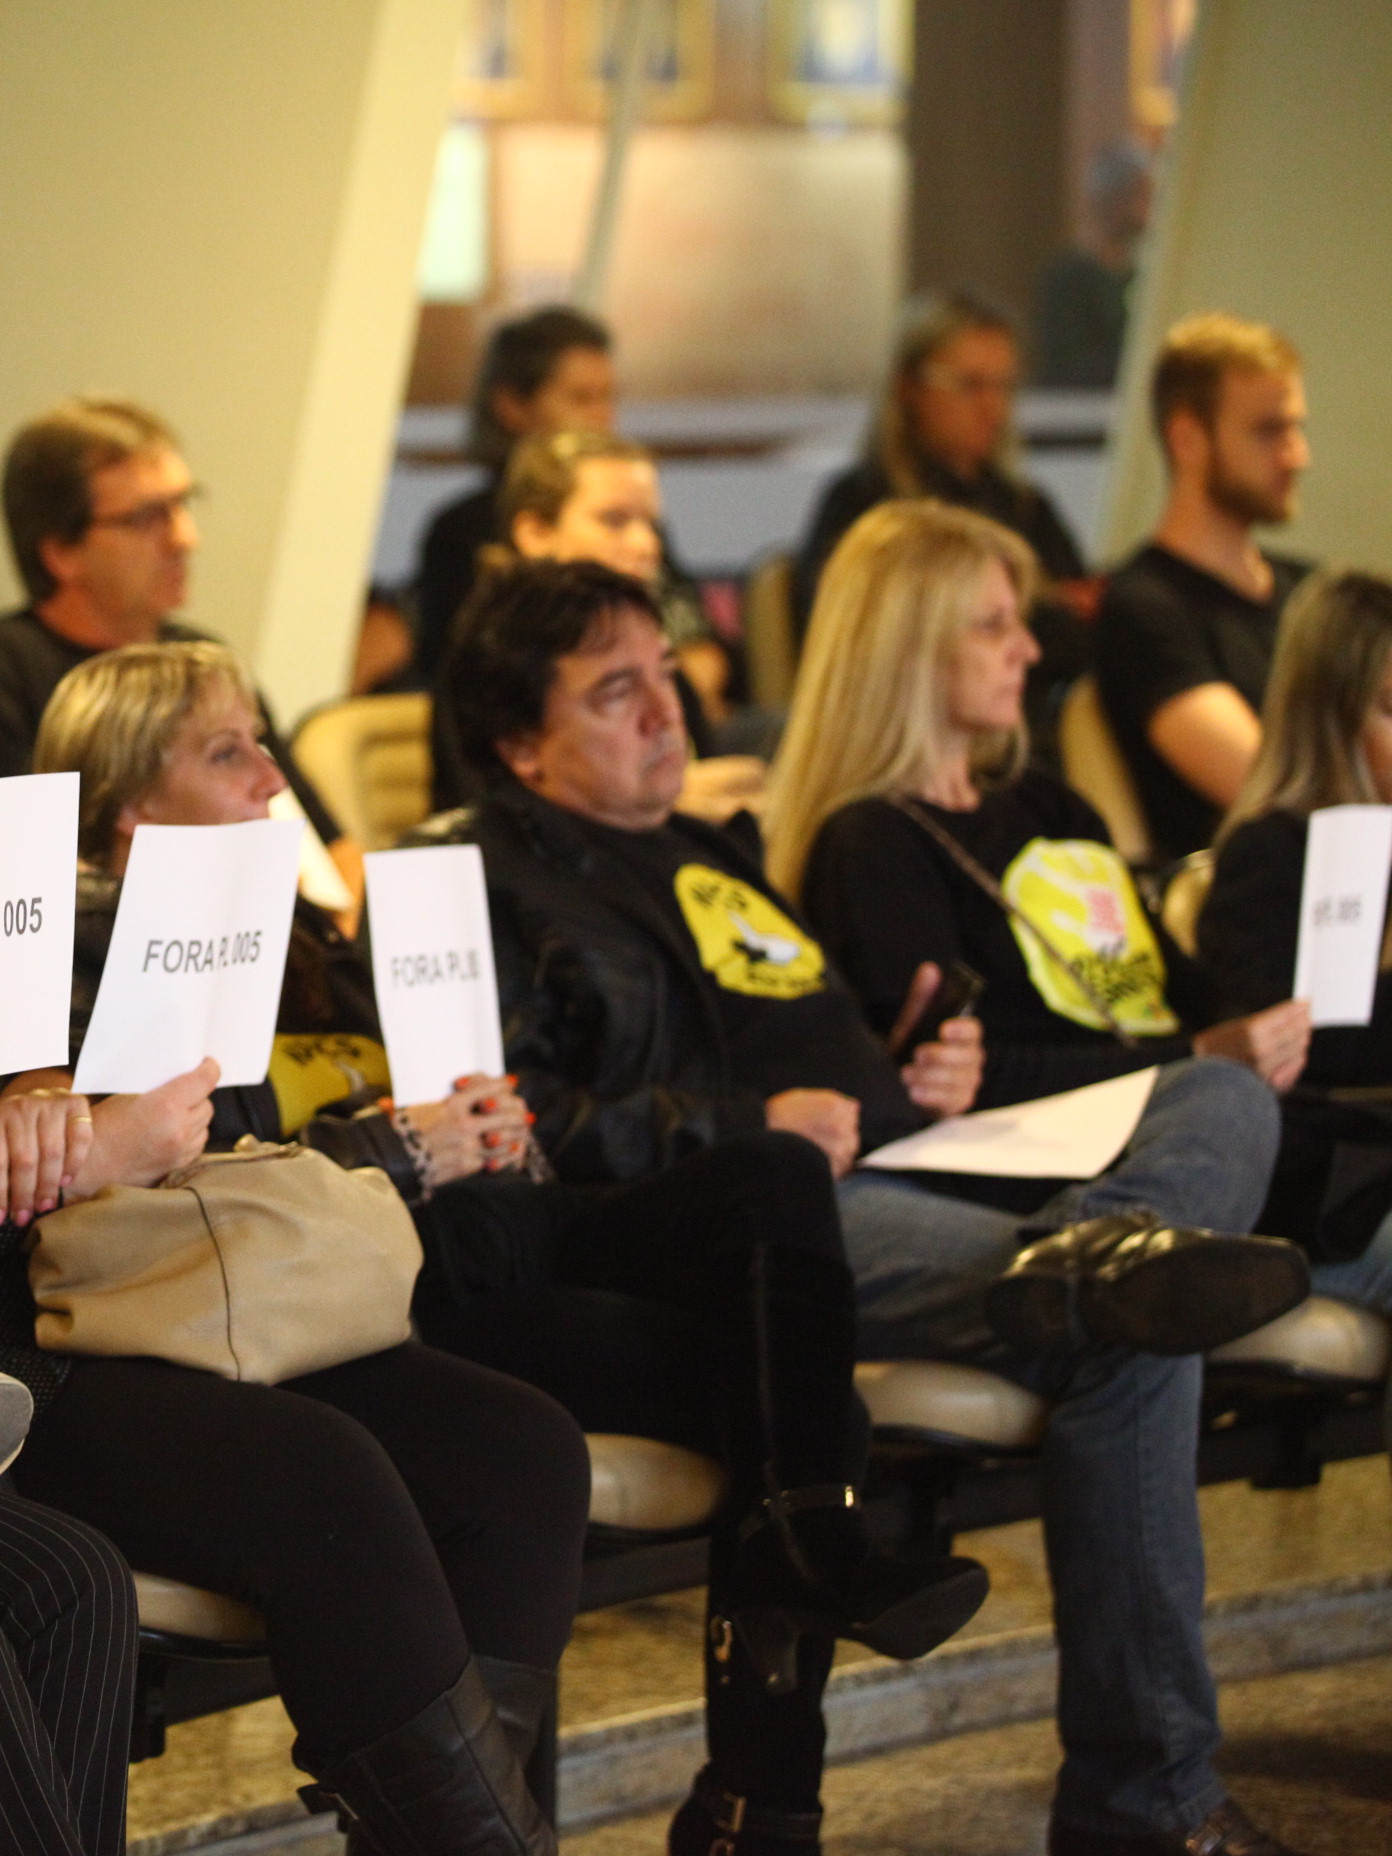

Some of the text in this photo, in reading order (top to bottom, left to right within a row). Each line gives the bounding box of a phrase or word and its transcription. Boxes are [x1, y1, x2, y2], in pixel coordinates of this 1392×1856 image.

[4, 897, 43, 938] 005
[142, 939, 214, 974] FORA
[232, 930, 262, 965] 005
[391, 953, 444, 990] FORA
